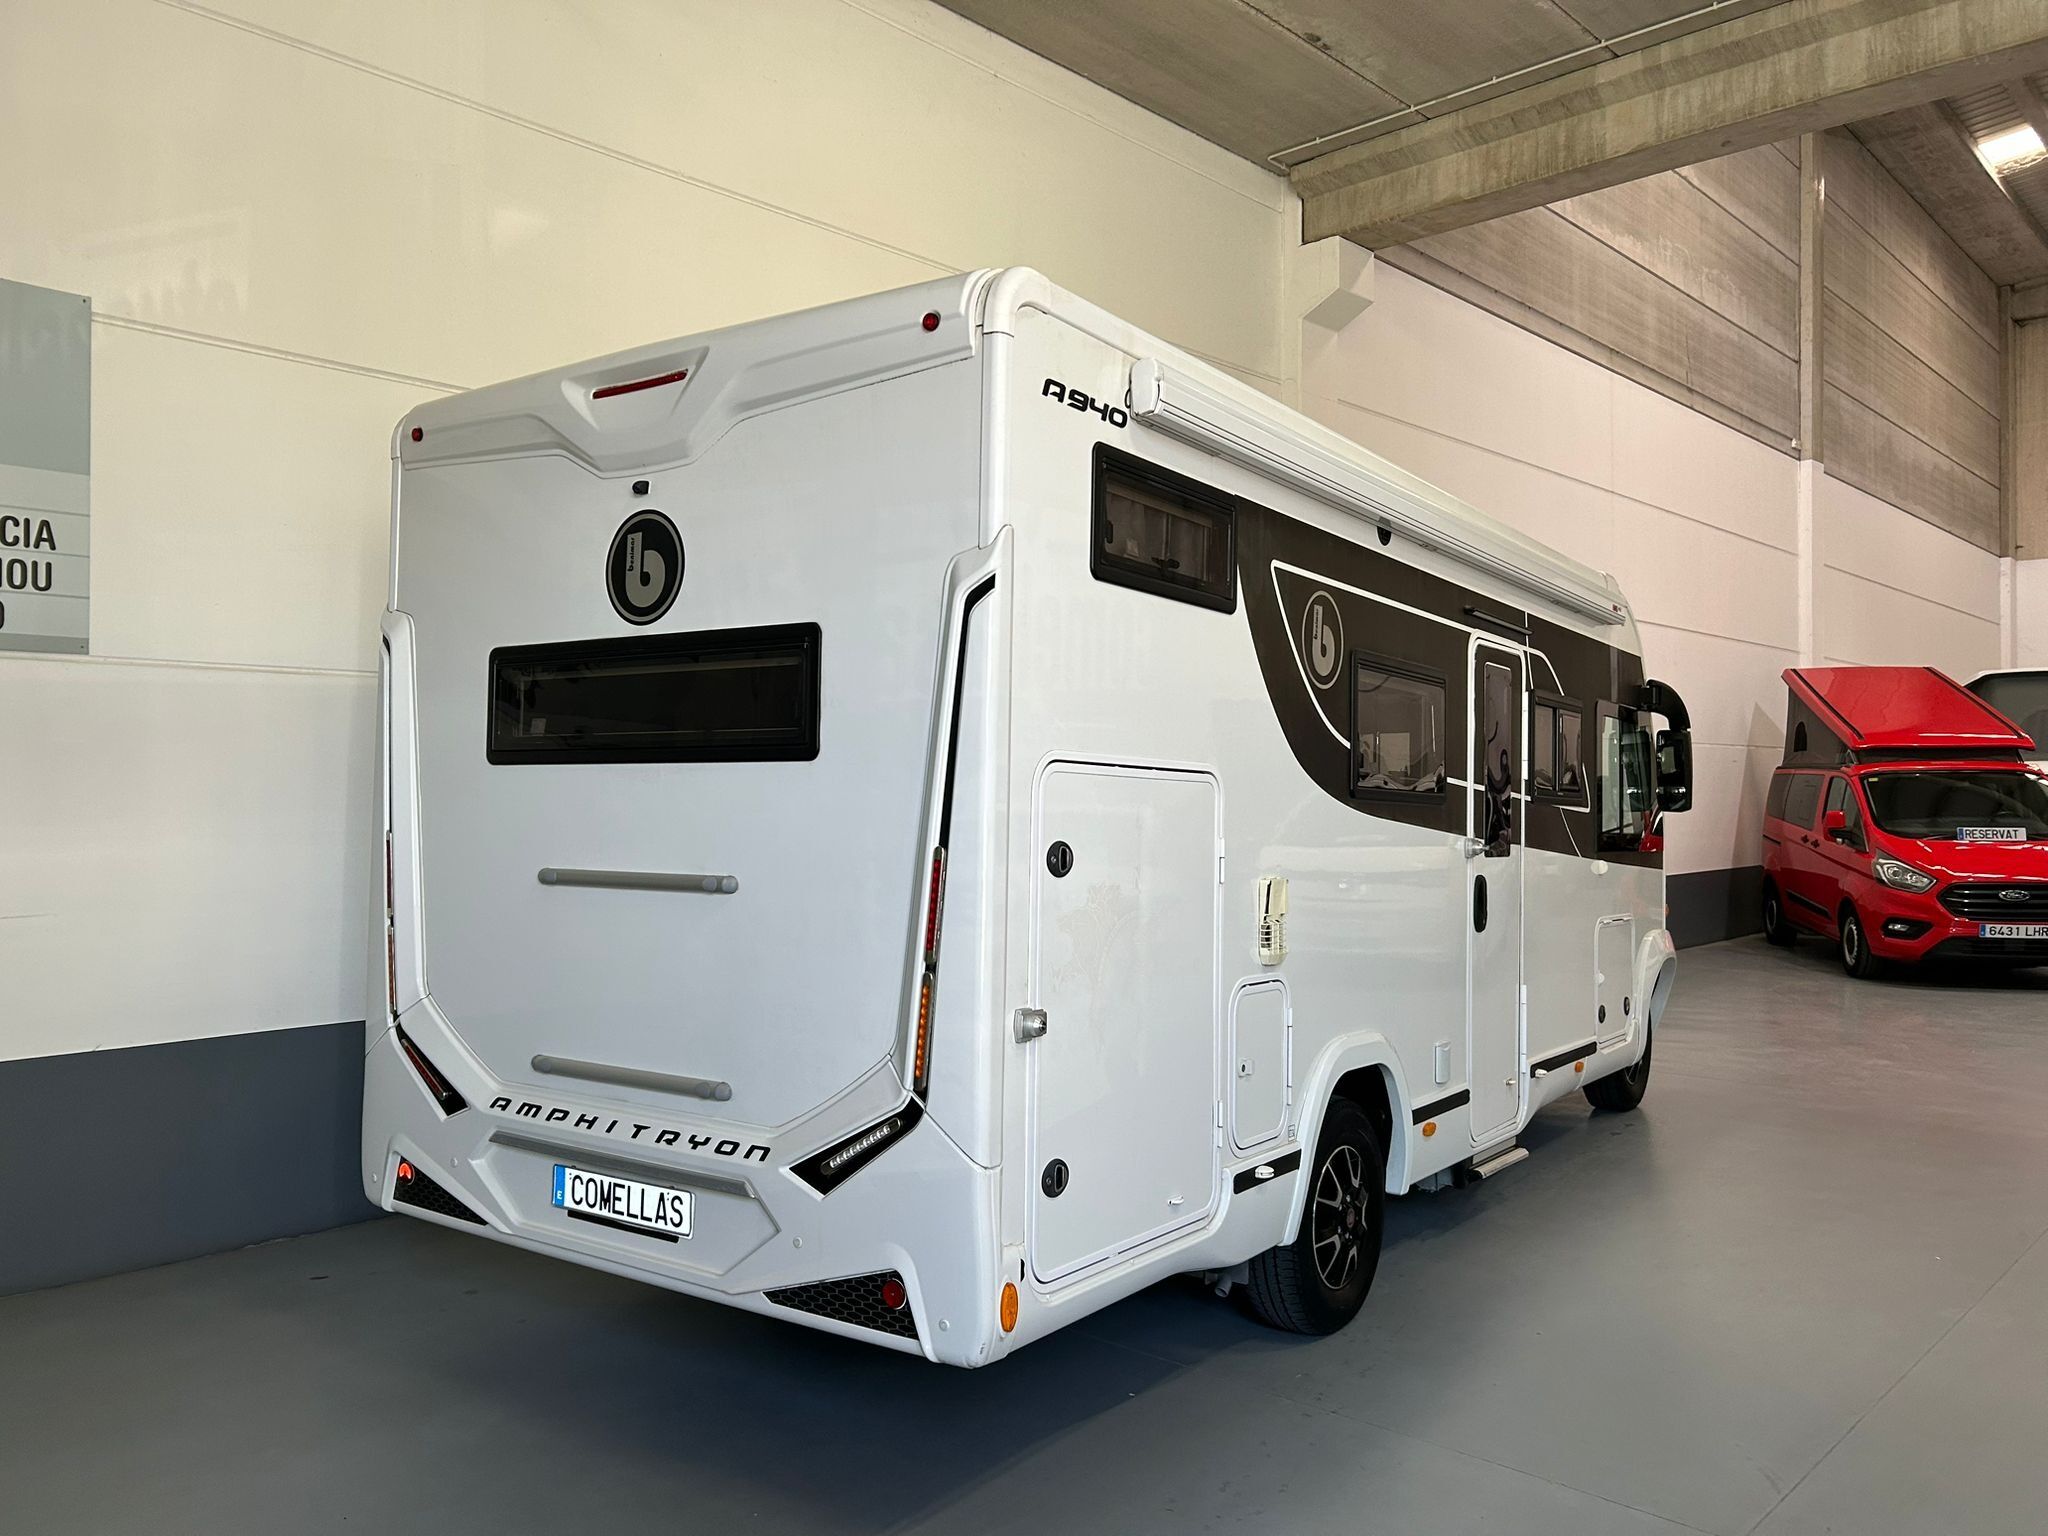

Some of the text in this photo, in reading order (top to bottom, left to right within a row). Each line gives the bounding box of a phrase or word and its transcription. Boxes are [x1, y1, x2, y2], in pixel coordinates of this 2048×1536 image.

[0, 515, 56, 551] CIA
[0, 557, 52, 592] OU
[1964, 829, 2019, 839] RESERVAT
[1989, 926, 2048, 937] 6431 LHR
[489, 1096, 771, 1162] AMPHITRYON
[571, 1174, 684, 1228] COMELLAS
